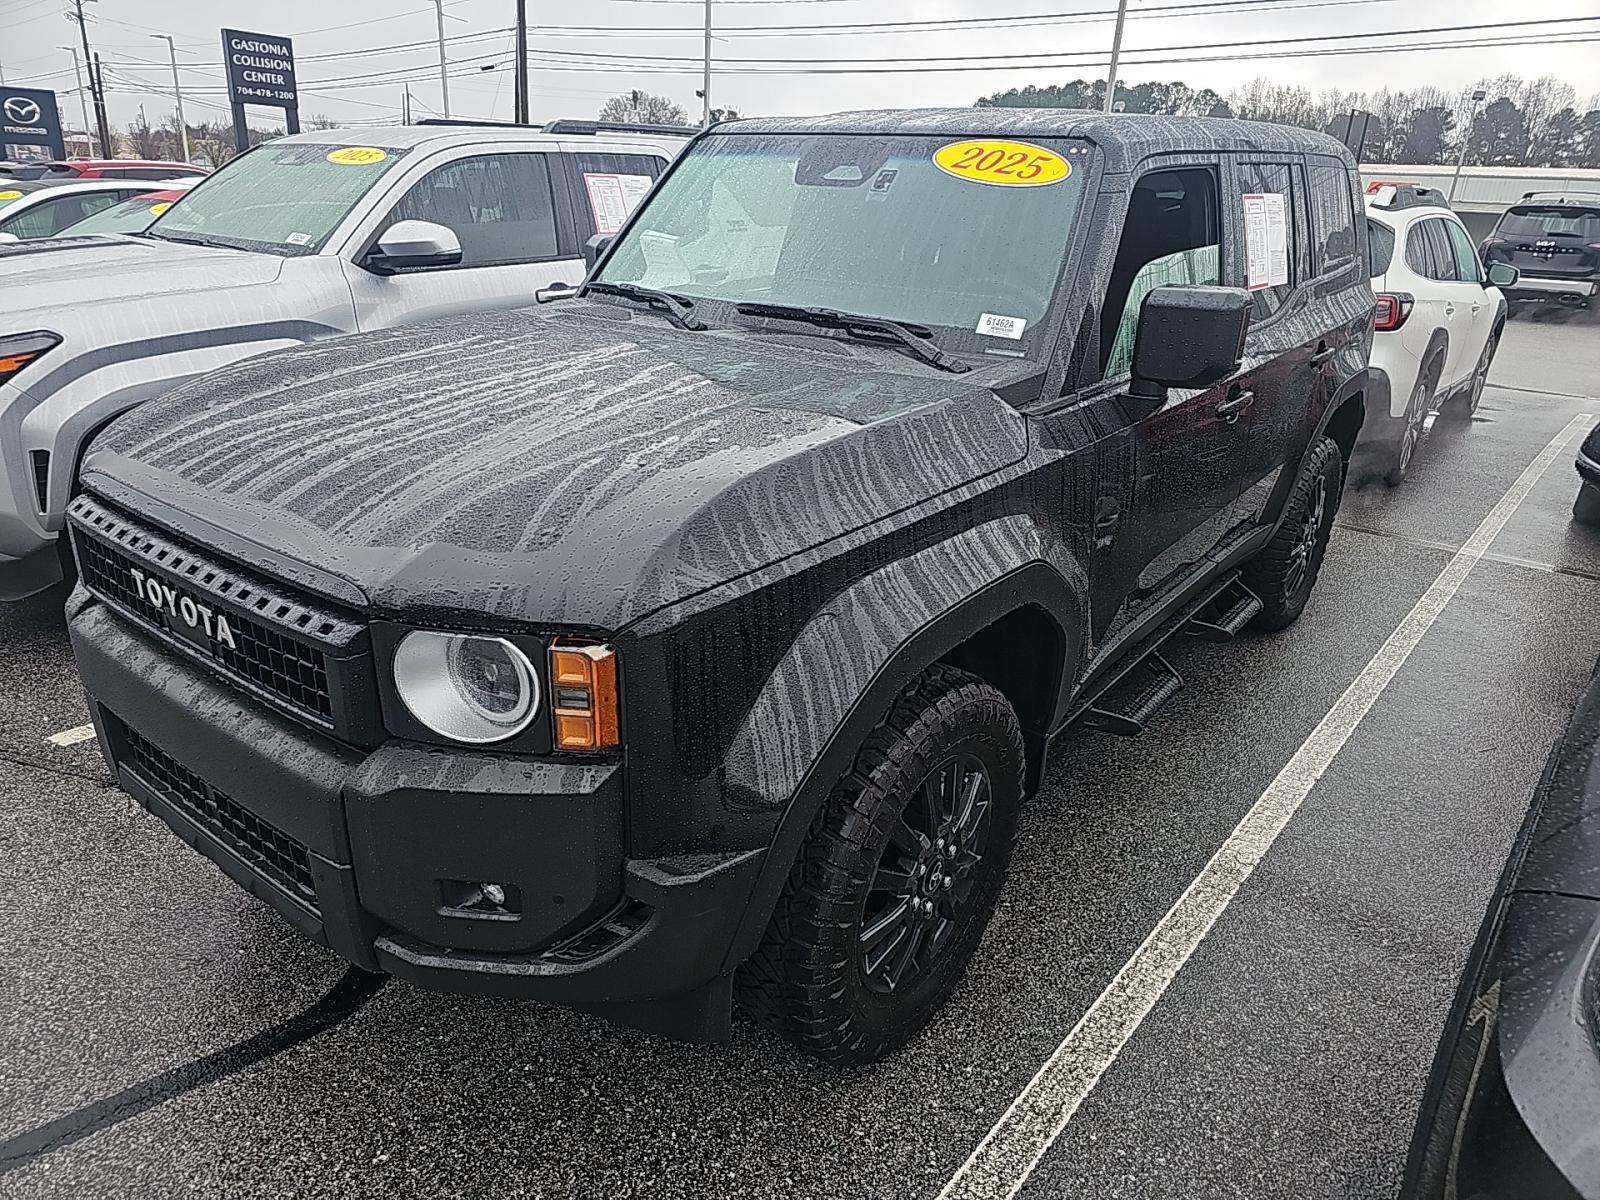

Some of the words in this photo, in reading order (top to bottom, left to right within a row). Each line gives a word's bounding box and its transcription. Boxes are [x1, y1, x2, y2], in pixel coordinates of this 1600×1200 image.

[231, 38, 289, 56] GASTONIA
[232, 54, 292, 71] COLLISION
[243, 70, 285, 85] CENTER
[236, 86, 295, 100] 704-478-1200
[950, 147, 1053, 179] 2025
[130, 567, 236, 649] TOYOTA
